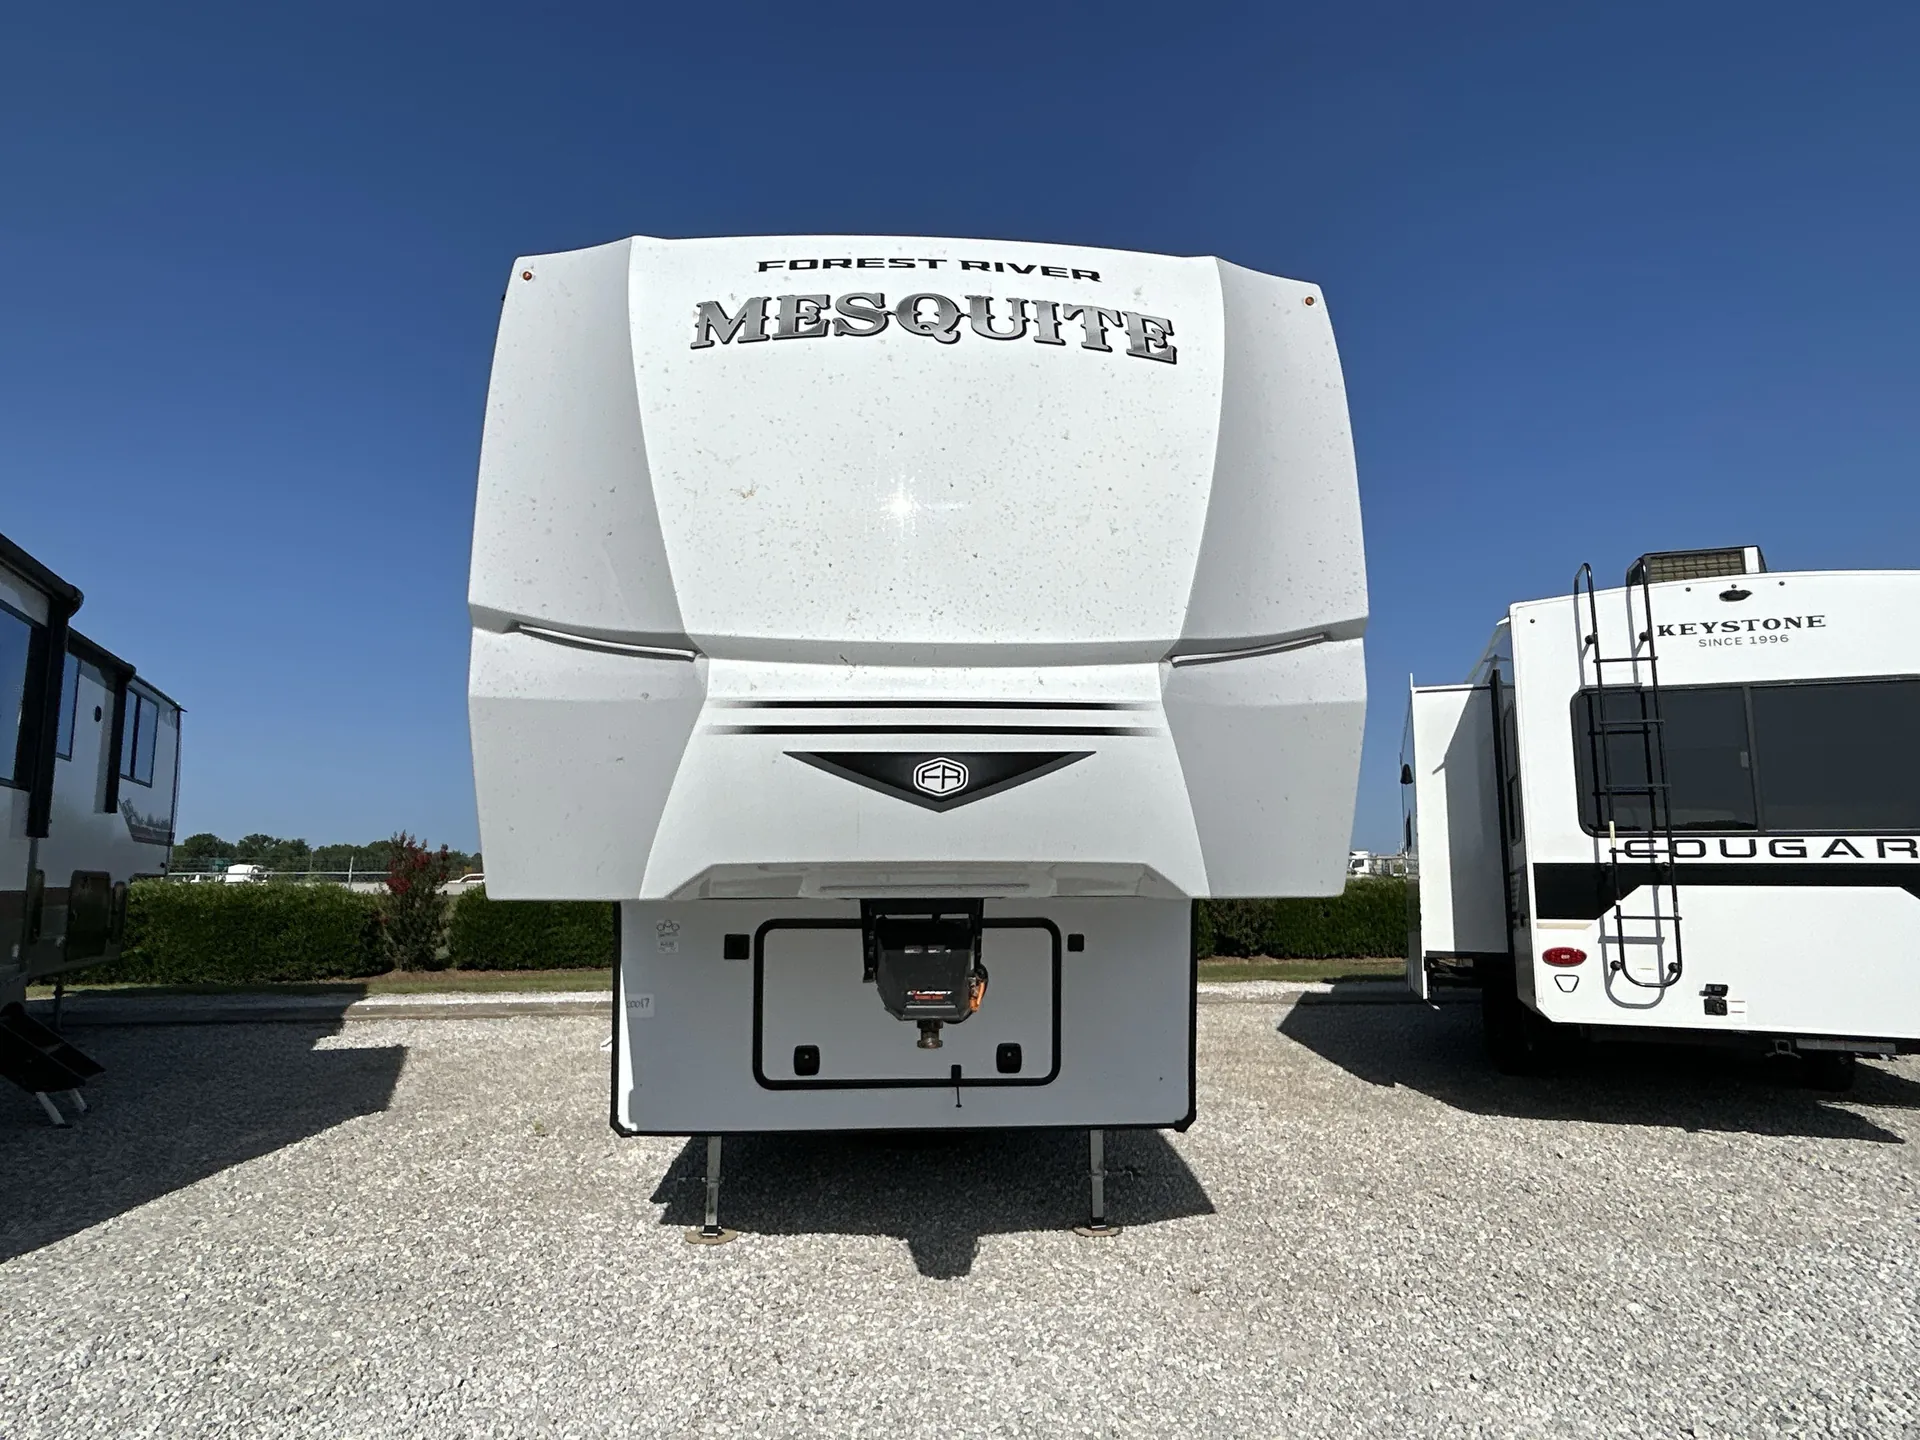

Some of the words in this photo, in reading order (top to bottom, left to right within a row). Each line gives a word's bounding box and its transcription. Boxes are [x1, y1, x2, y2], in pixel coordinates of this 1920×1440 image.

[757, 258, 947, 273] FOREST
[958, 259, 1103, 283] RIVER
[690, 292, 1178, 365] MESQUITE
[1656, 614, 1827, 637] KEYSTONE
[1698, 637, 1743, 648] SINCE
[1749, 634, 1790, 645] 1996
[1623, 838, 1920, 859] COUGAR
